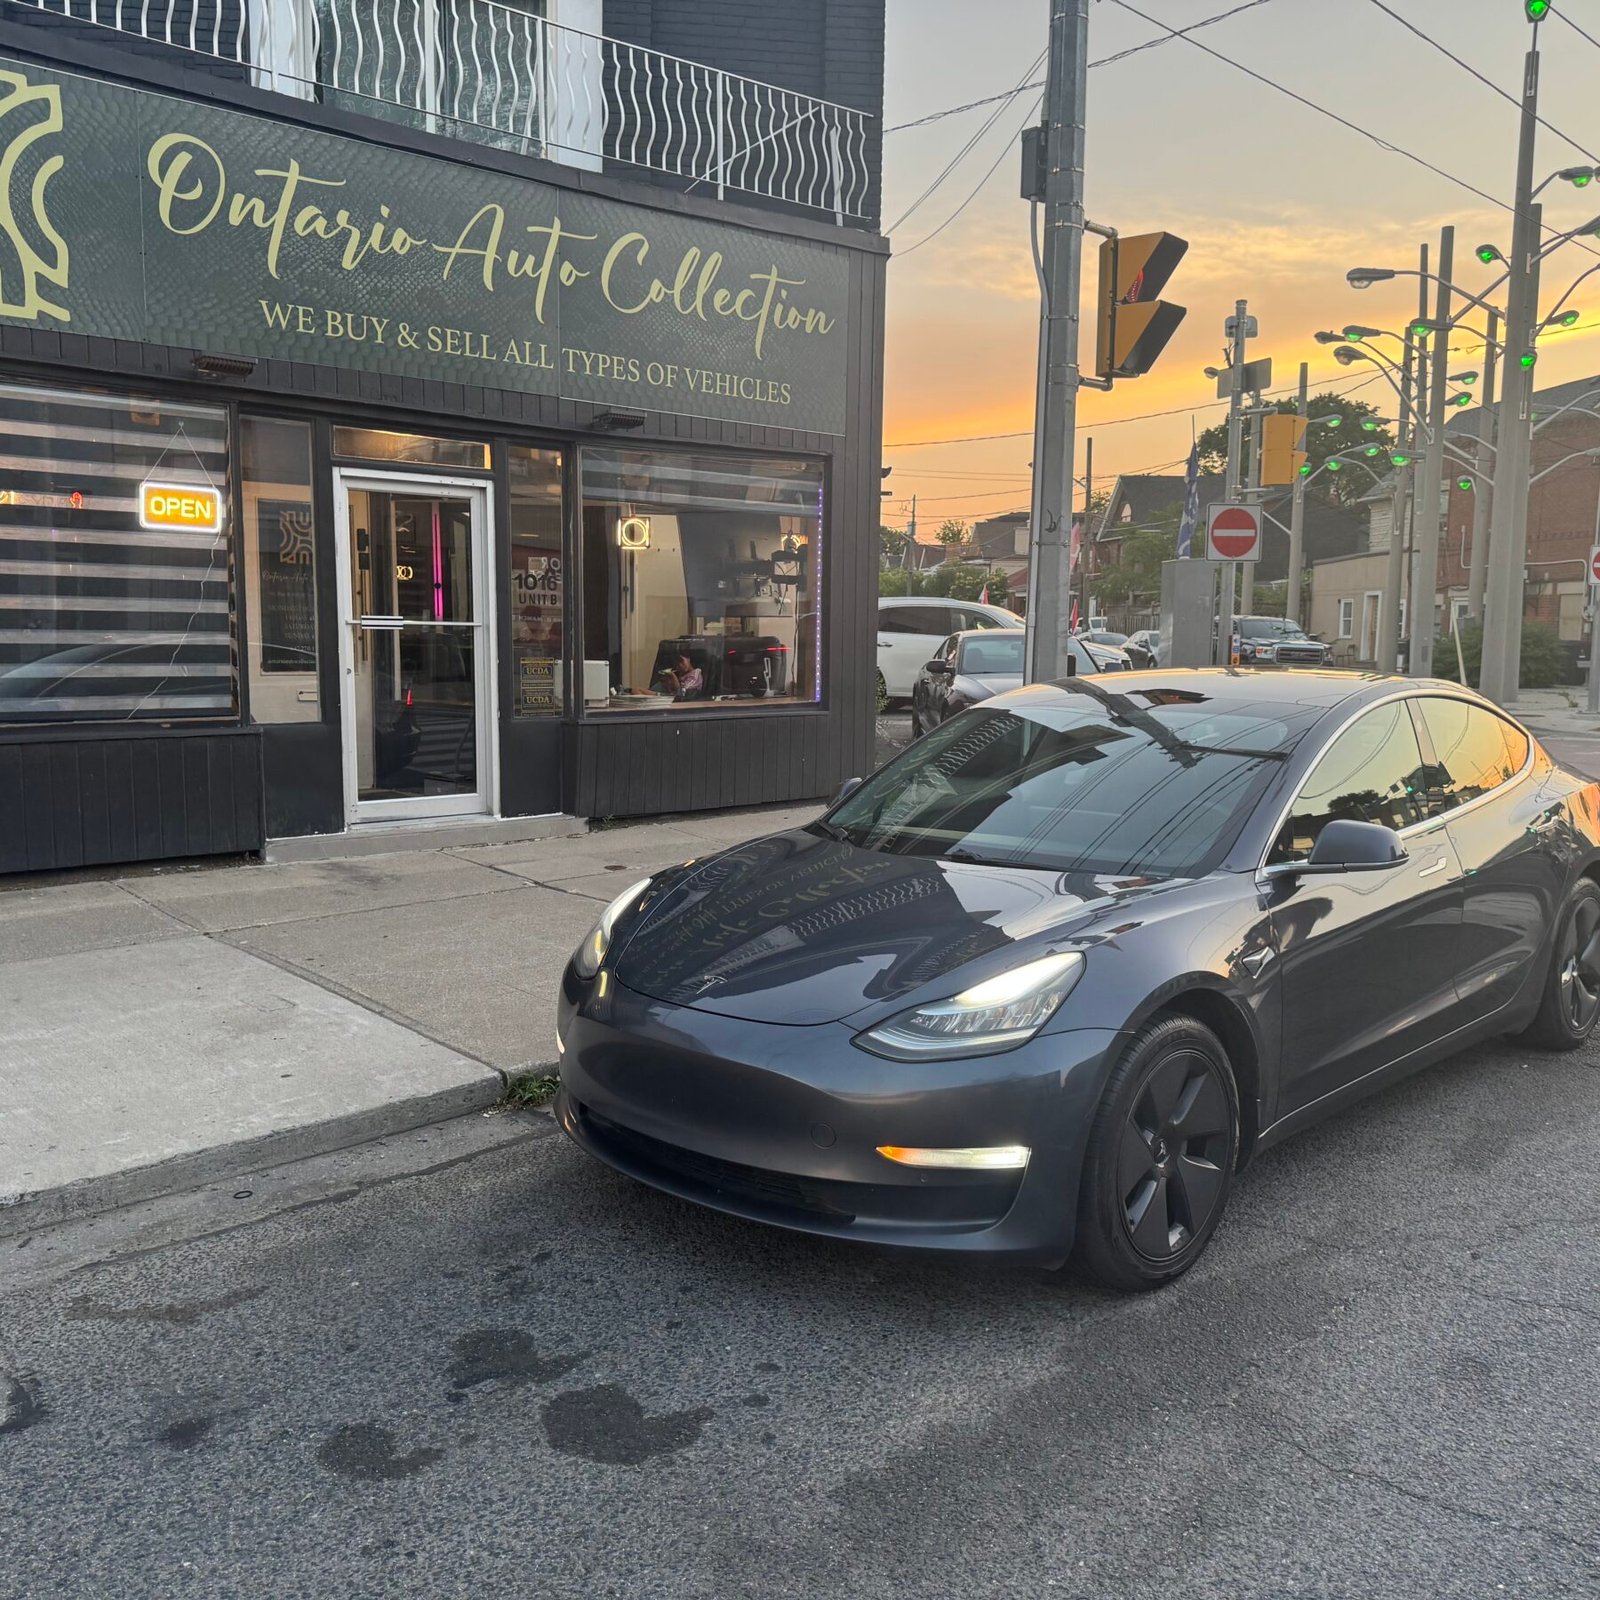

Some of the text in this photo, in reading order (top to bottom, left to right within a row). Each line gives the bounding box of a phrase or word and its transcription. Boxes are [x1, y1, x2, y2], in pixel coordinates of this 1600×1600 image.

[147, 133, 836, 361] Ontario Auto Collection
[258, 299, 792, 405] WE BUY & SELL ALL TYPES OF VEHICLES
[149, 495, 212, 520] OPEN
[512, 573, 558, 591] 1016
[518, 593, 558, 606] UNIT B
[526, 667, 549, 675] UCDA
[526, 696, 550, 704] UCDA
